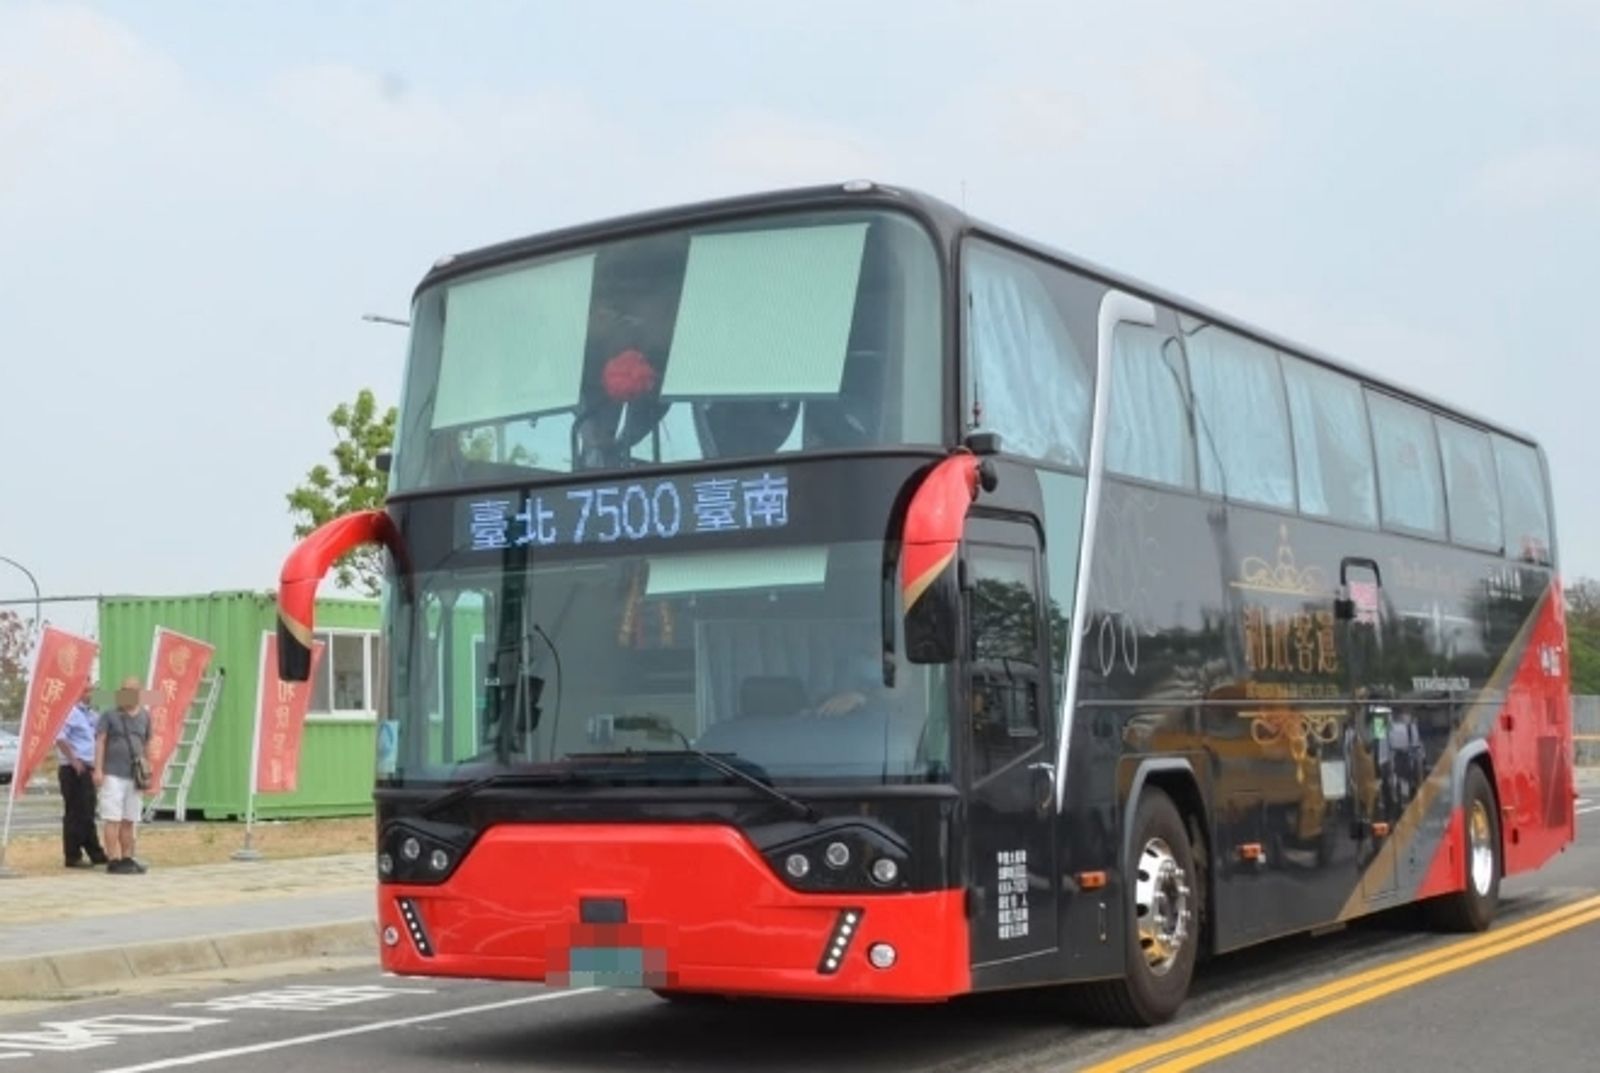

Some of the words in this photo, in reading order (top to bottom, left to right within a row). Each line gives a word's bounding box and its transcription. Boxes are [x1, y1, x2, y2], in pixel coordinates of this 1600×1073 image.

[469, 497, 557, 551] 臺北
[566, 481, 681, 544] 7500
[692, 472, 790, 533] 臺南
